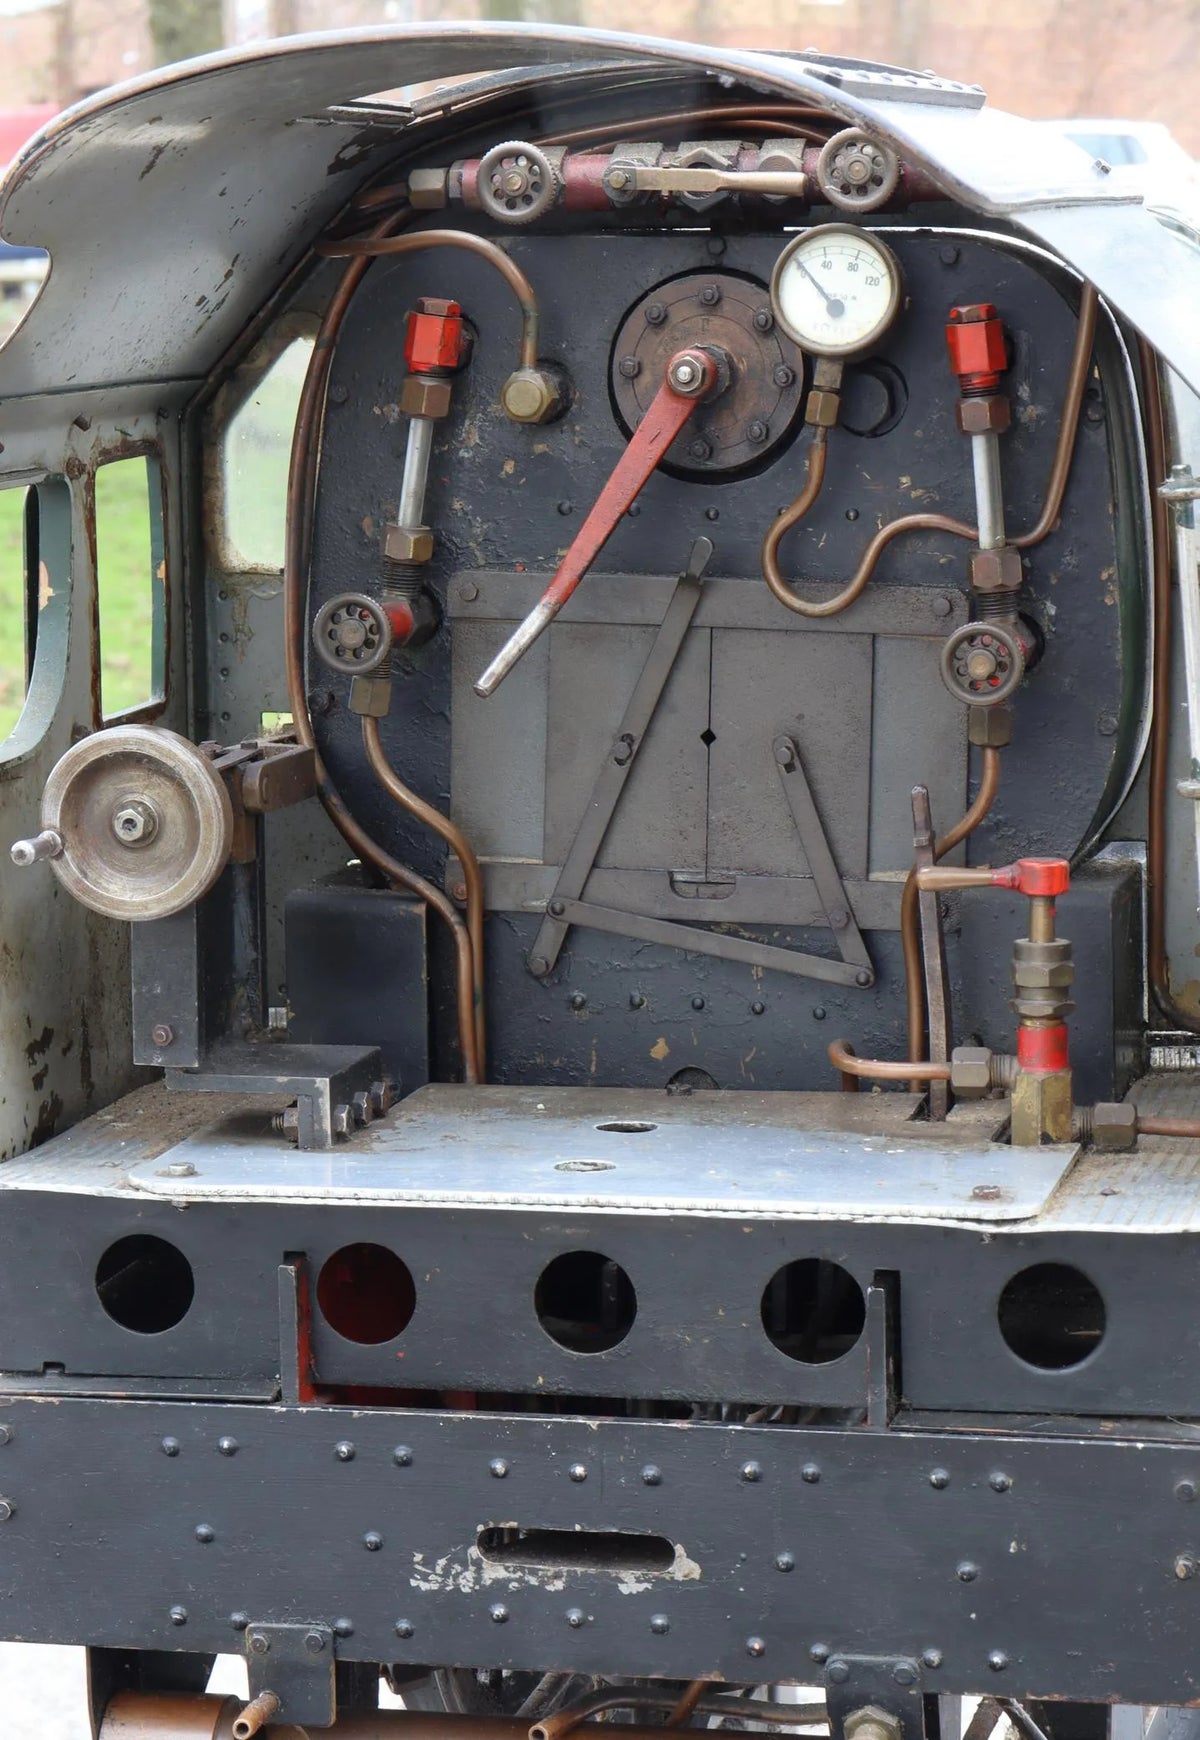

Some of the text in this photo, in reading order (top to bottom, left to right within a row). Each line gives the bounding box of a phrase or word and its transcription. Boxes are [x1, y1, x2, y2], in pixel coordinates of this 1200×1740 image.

[820, 260, 833, 270] 40
[847, 262, 859, 272] 80
[864, 275, 880, 287] 120
